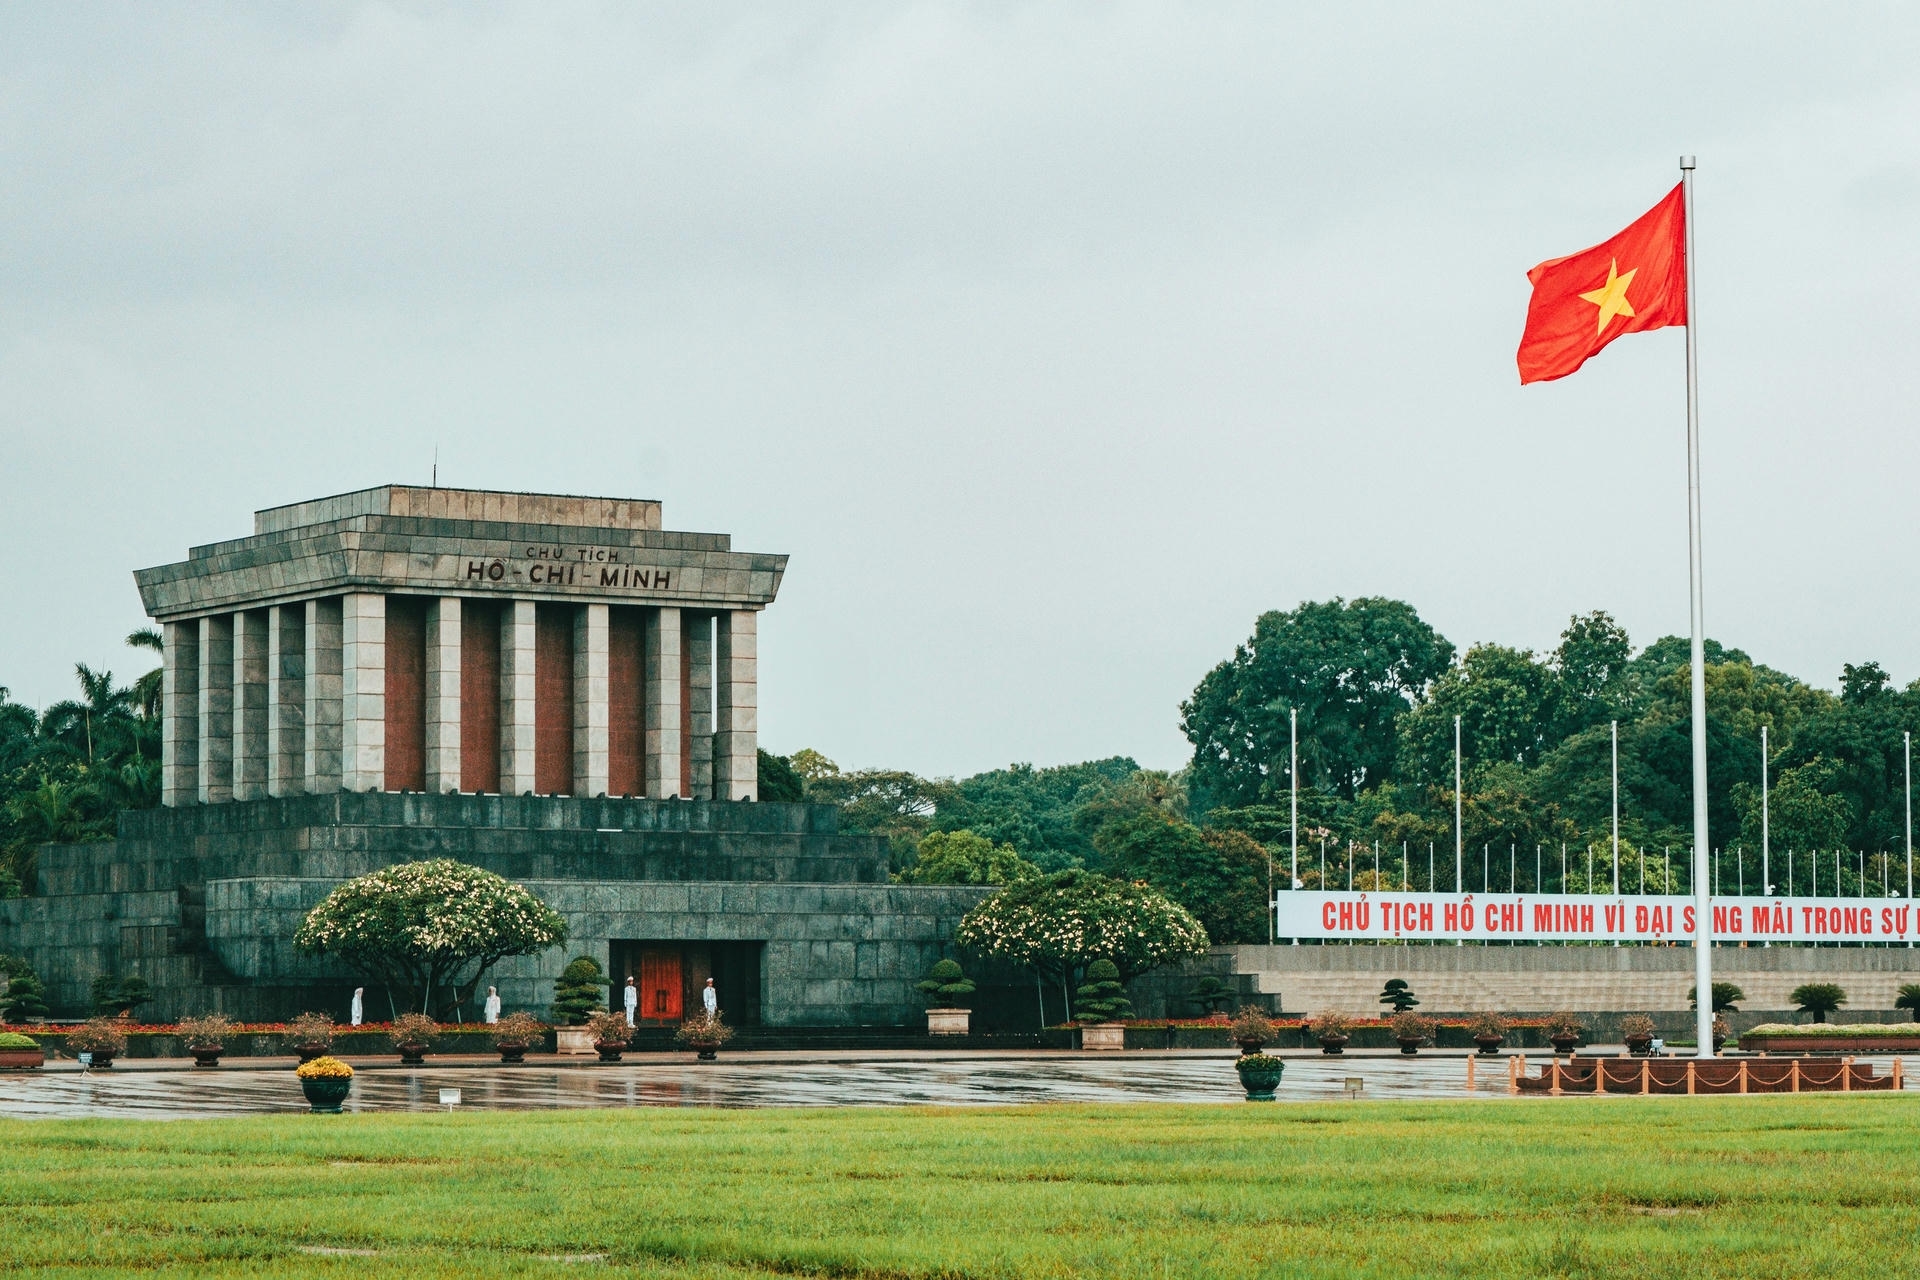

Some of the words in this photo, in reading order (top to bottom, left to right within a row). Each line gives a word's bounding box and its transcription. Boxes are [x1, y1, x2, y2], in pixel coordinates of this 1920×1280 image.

[1322, 894, 1370, 931] CHỦ
[1380, 902, 1434, 937] TỊCH
[1444, 894, 1475, 932] HỒ
[1485, 897, 1524, 932] CHÍ
[1533, 904, 1594, 933] MINH
[1635, 905, 1673, 938] ĐẠI
[1683, 897, 1743, 934] SNG
[1752, 901, 1793, 934] MÃI
[1801, 906, 1873, 935] TRONG
[1881, 903, 1910, 940] SỰ
